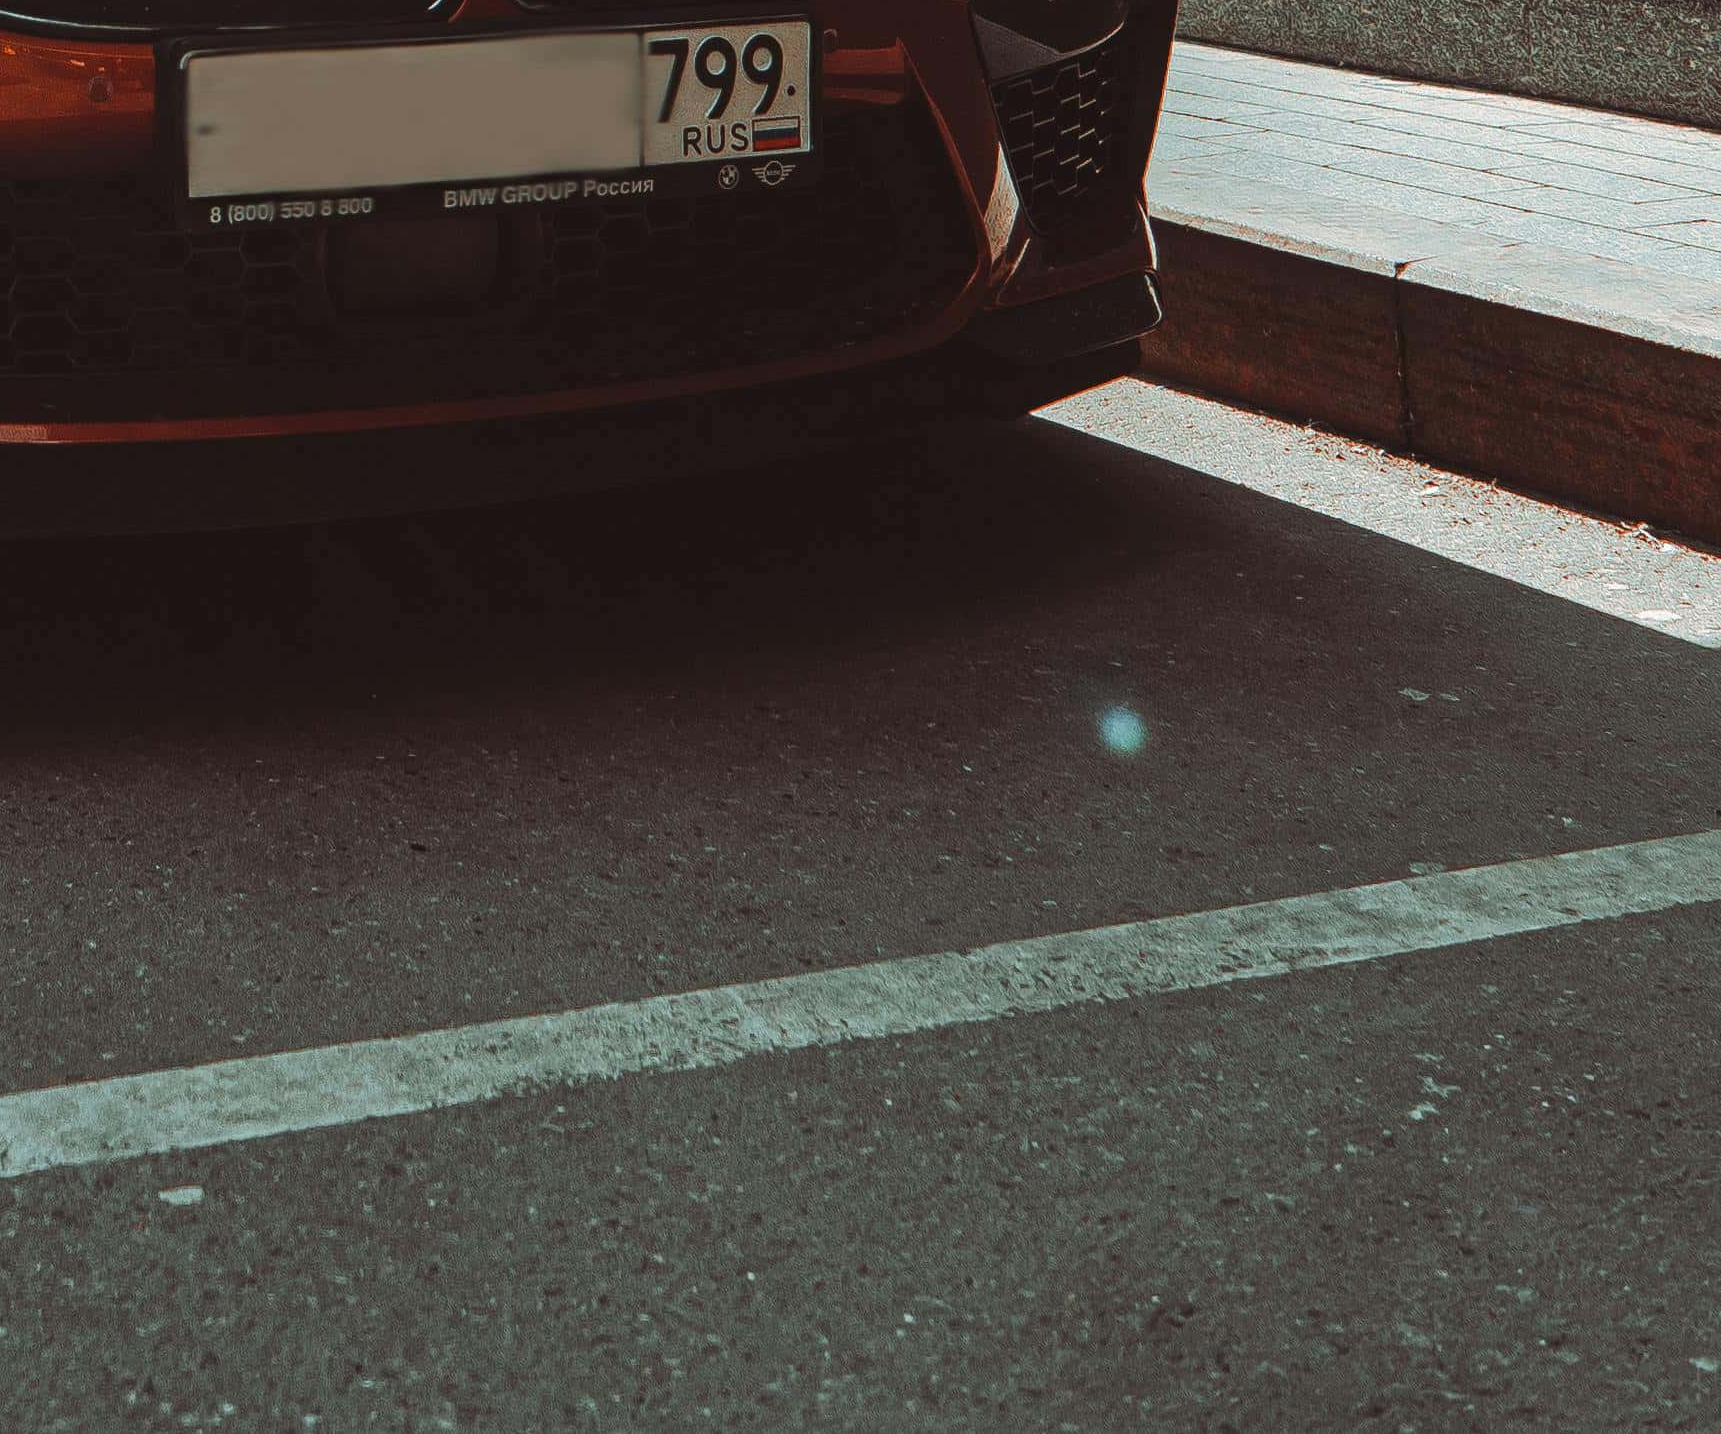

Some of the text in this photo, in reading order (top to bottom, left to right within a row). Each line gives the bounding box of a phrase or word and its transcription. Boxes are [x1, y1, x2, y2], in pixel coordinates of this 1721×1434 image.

[647, 32, 784, 124] 799
[682, 121, 750, 157] RUS
[443, 178, 655, 208] BMW GROUP Россия
[209, 205, 222, 224] 8
[227, 202, 275, 225] (800)
